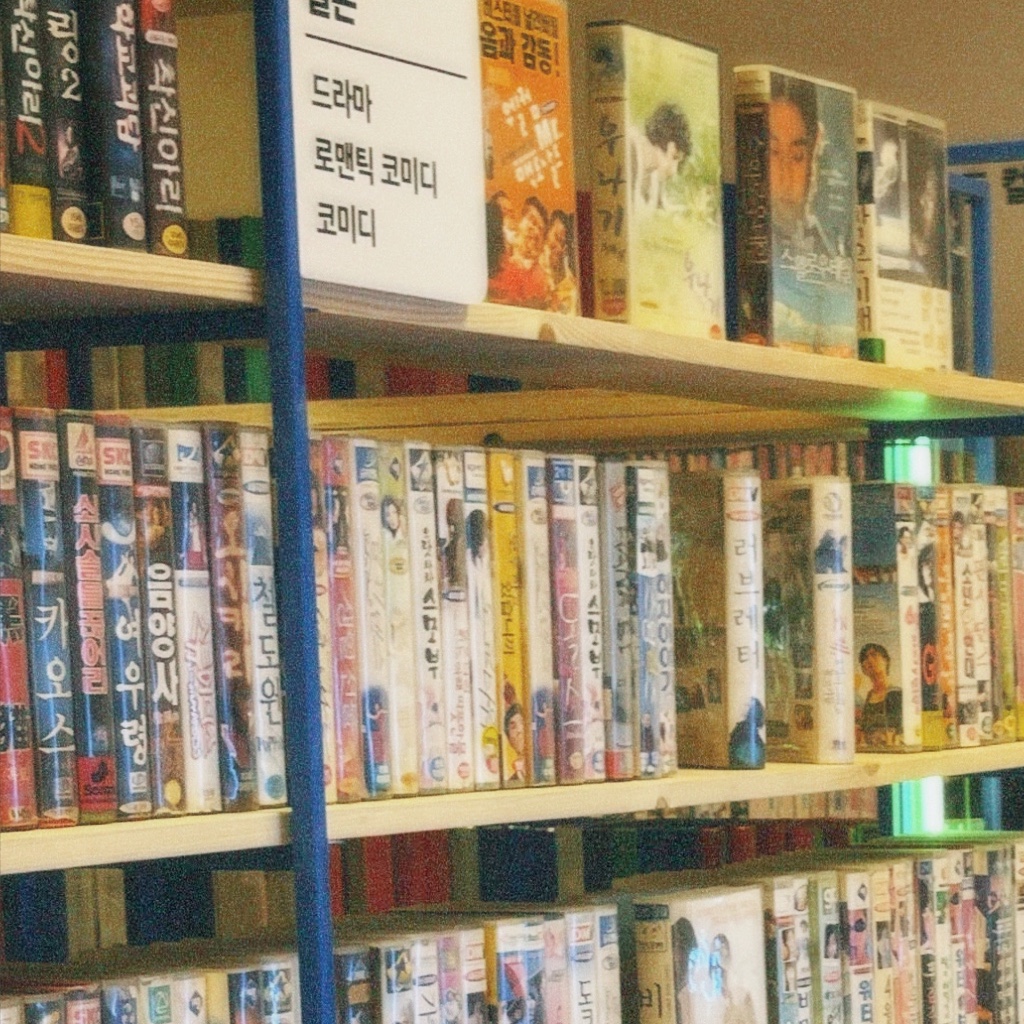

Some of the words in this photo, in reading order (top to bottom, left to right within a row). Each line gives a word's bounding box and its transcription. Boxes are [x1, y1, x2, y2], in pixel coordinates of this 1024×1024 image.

[147, 57, 184, 214] 착신아리
[310, 73, 372, 124] 드라마
[313, 137, 376, 185] 로맨틱
[380, 152, 439, 199] 코미디
[316, 201, 379, 248] 코미디
[147, 563, 179, 708] 음양사
[252, 577, 282, 727] 철도원
[733, 535, 760, 671] 러브레터
[36, 598, 76, 756] 카오스
[114, 612, 147, 766] 여우령
